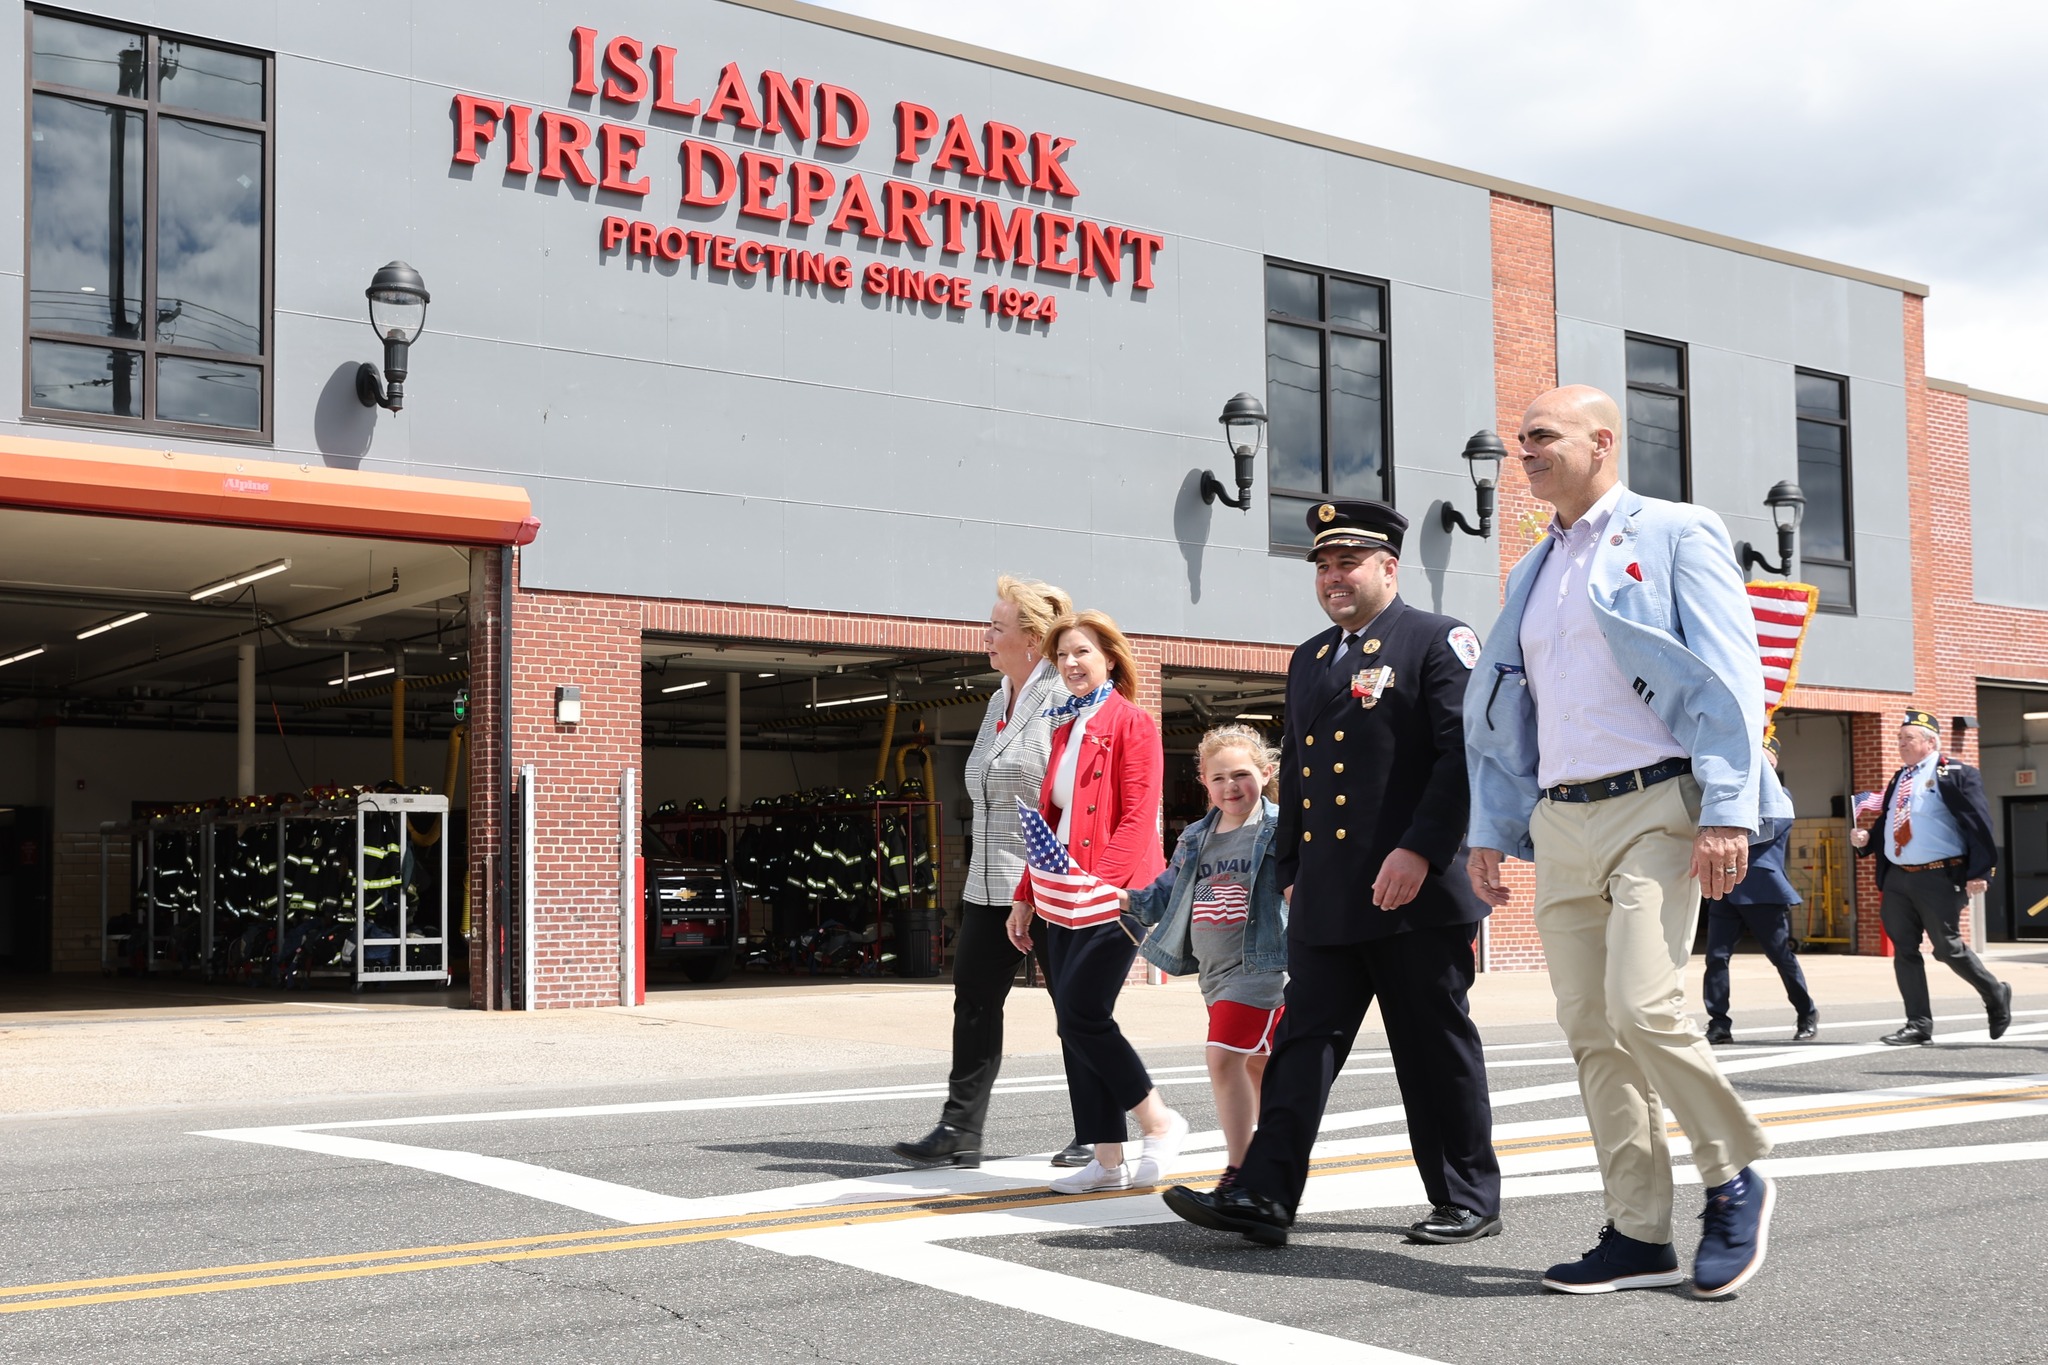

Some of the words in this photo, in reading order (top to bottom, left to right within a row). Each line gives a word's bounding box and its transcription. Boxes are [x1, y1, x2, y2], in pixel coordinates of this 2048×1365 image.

[572, 25, 870, 148] ISLAND
[896, 100, 1081, 198] PARK
[453, 93, 651, 197] FIRE
[682, 139, 1165, 290] DEPARTMENT
[602, 215, 854, 289] PROTECTING
[864, 261, 973, 310] SINCE
[983, 284, 1059, 323] 1924
[224, 478, 270, 492] Alpine
[1216, 858, 1252, 874] NAV
